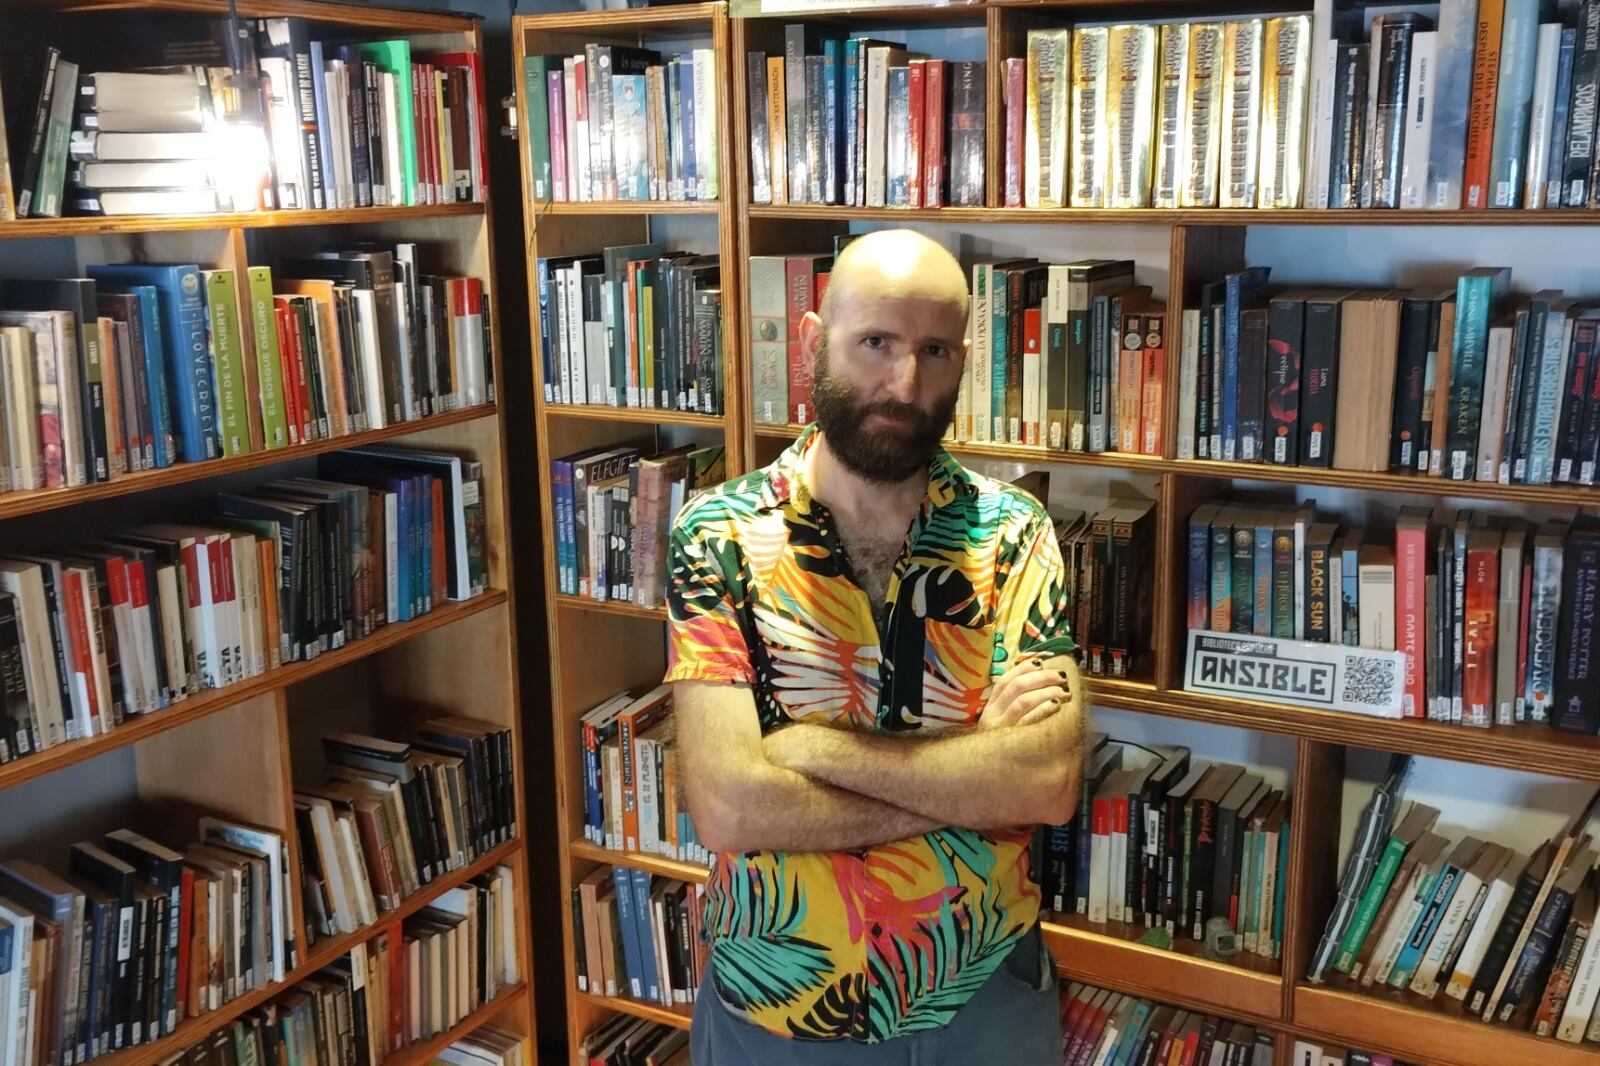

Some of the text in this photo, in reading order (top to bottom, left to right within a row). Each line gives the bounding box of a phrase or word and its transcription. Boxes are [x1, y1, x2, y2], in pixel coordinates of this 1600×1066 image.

[1048, 38, 1056, 73] KING
[1204, 31, 1214, 69] KING
[1278, 28, 1287, 65] STEPHEN
[1287, 27, 1296, 64] KING
[963, 62, 972, 89] KING
[1474, 73, 1484, 94] DEL
[1482, 51, 1497, 129] STEPHEN KING
[1190, 88, 1209, 199] INSOMNIA
[1229, 80, 1249, 198] CHRISTINE
[1468, 97, 1482, 160] ANOCHECER
[309, 134, 318, 169] HOLLAND
[799, 274, 808, 311] MARTIN
[1468, 289, 1477, 322] CHINA
[216, 304, 228, 350] MUERTE
[698, 318, 706, 355] MARTIN
[222, 354, 229, 368] LA
[258, 301, 276, 415] EL BOSQUE OSCURO
[191, 331, 211, 432] LOVECRAFT
[224, 372, 231, 387] DE
[1320, 368, 1329, 387] Luna
[1536, 339, 1562, 435] EXTRATERRESTRES
[228, 413, 235, 426] EL
[1458, 387, 1470, 434] KRAKEN
[591, 454, 637, 483] ELFGIFT
[1311, 550, 1324, 630] BLACK SUN
[1577, 569, 1596, 679] HARRY POTTER
[1405, 614, 1414, 685] MARTE ROJO
[1201, 656, 1326, 696] ANSIBLE
[1433, 872, 1455, 904] REGRESO
